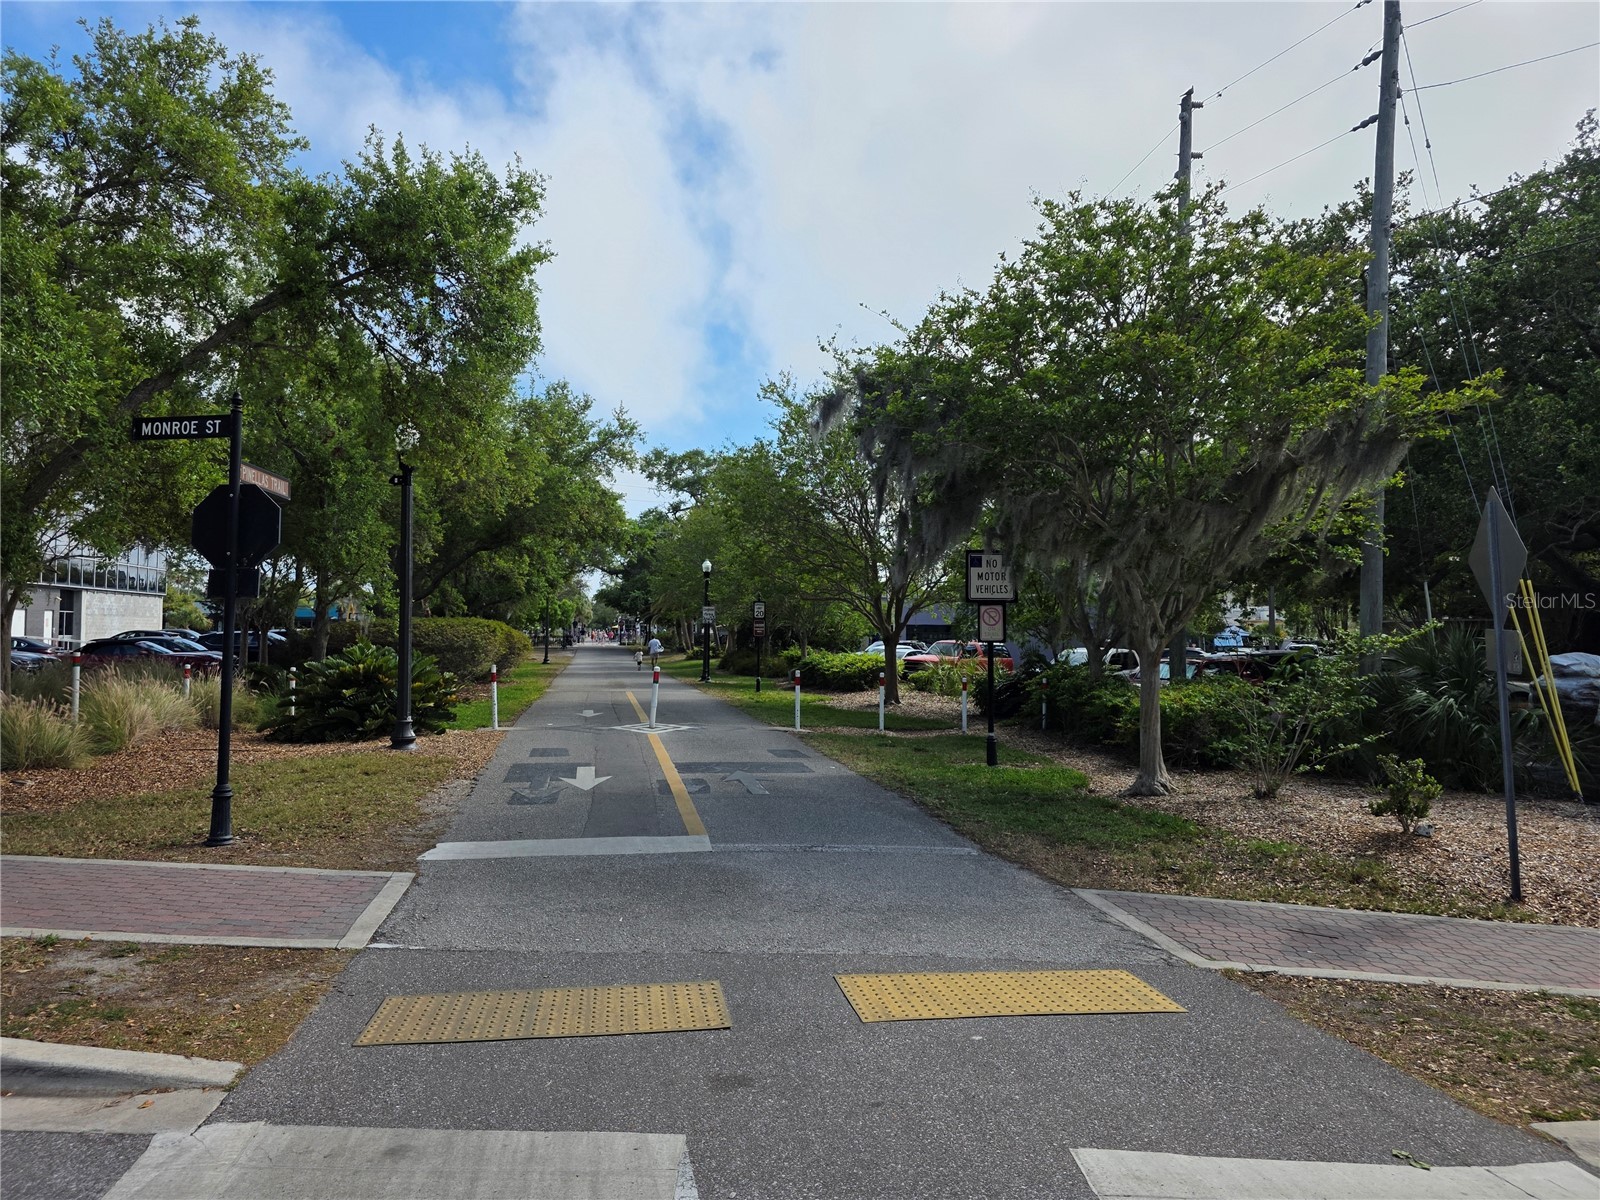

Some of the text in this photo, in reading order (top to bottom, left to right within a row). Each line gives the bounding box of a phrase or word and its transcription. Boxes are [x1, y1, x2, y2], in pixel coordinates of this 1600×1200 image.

[142, 420, 222, 436] MONROE ST
[271, 478, 287, 495] TRAIL
[986, 560, 998, 568] NO
[978, 572, 1006, 580] MOTOR
[976, 584, 1008, 594] VEHICLES
